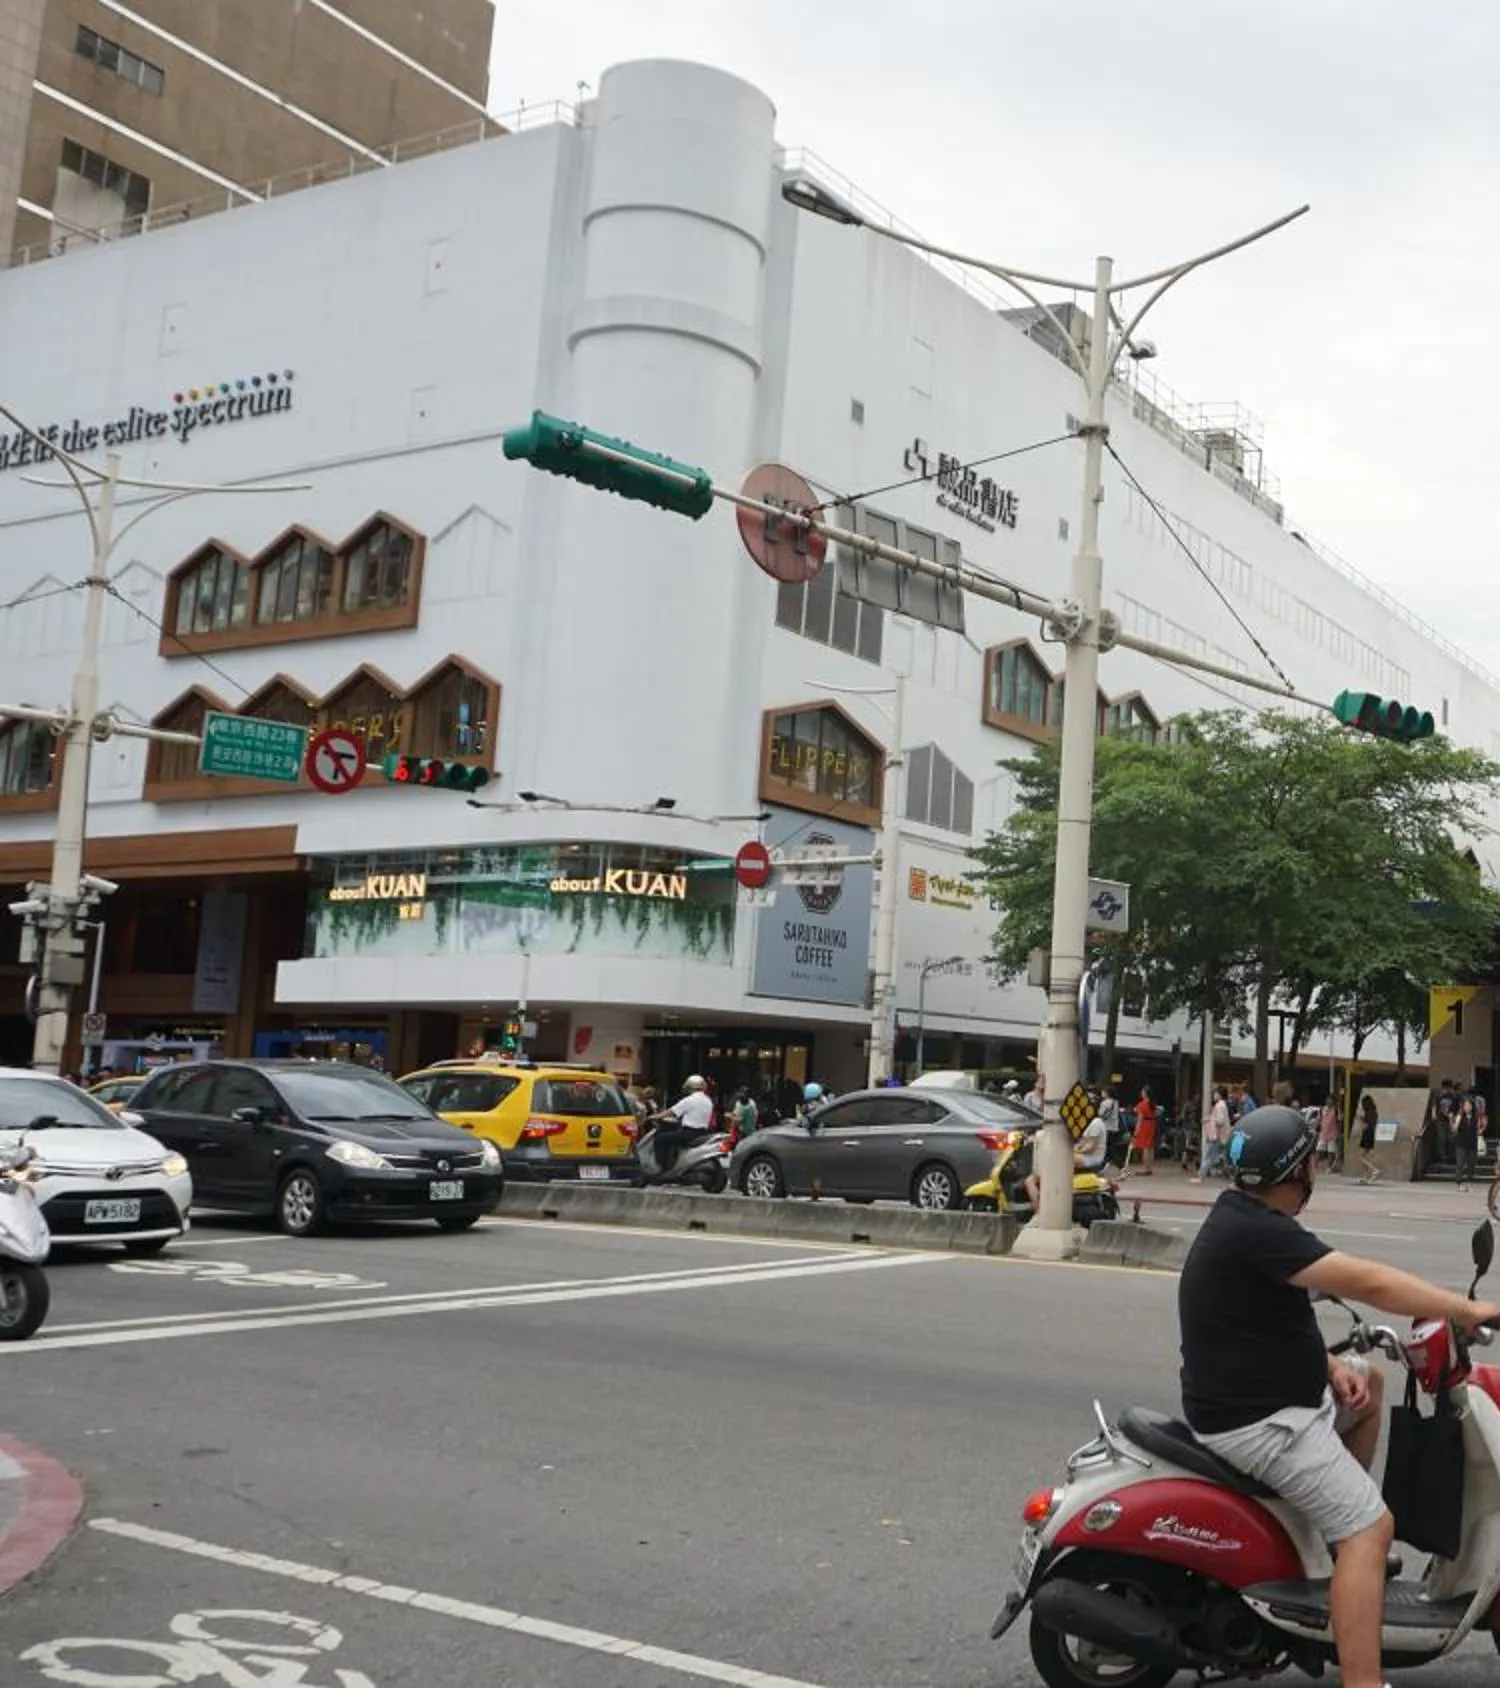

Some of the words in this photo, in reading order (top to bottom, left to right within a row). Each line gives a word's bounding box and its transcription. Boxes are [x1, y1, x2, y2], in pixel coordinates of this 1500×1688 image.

[62, 419, 98, 452] the
[102, 407, 168, 447] eslite
[170, 386, 293, 445] spectrum
[330, 886, 366, 900] about
[367, 874, 426, 899] KUAN
[550, 876, 601, 892] about
[604, 869, 687, 900] KUAN
[795, 944, 833, 968] COFFEE
[1447, 998, 1463, 1035] 1
